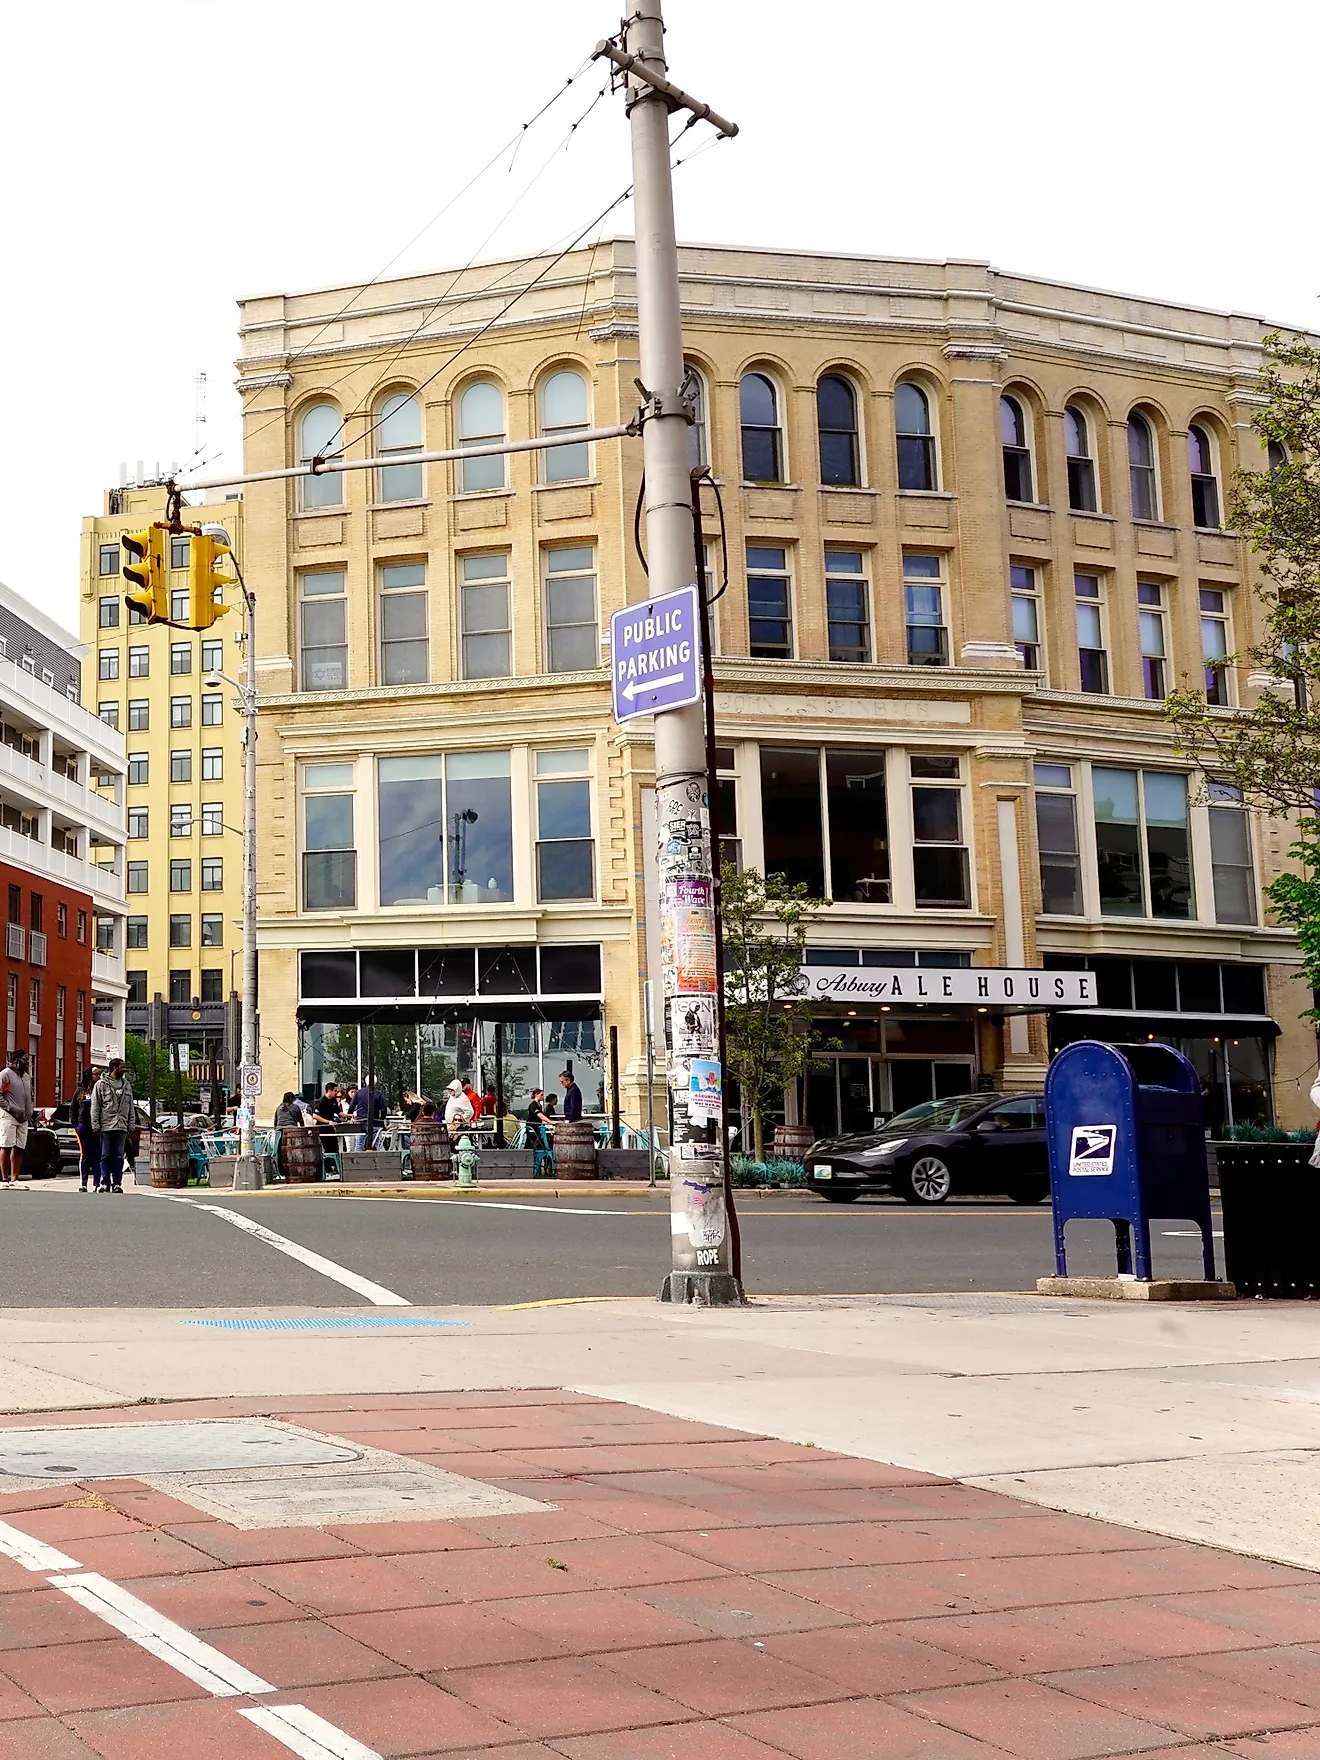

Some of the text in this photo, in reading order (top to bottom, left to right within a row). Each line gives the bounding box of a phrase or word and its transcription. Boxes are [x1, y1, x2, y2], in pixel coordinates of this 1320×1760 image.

[623, 609, 683, 648] PUBLIC
[618, 640, 691, 682] PARKING
[678, 885, 706, 896] Fourth
[682, 895, 706, 905] Wave
[816, 973, 1090, 999] Asbury ALE HOUSE
[696, 1248, 720, 1266] ROPE
